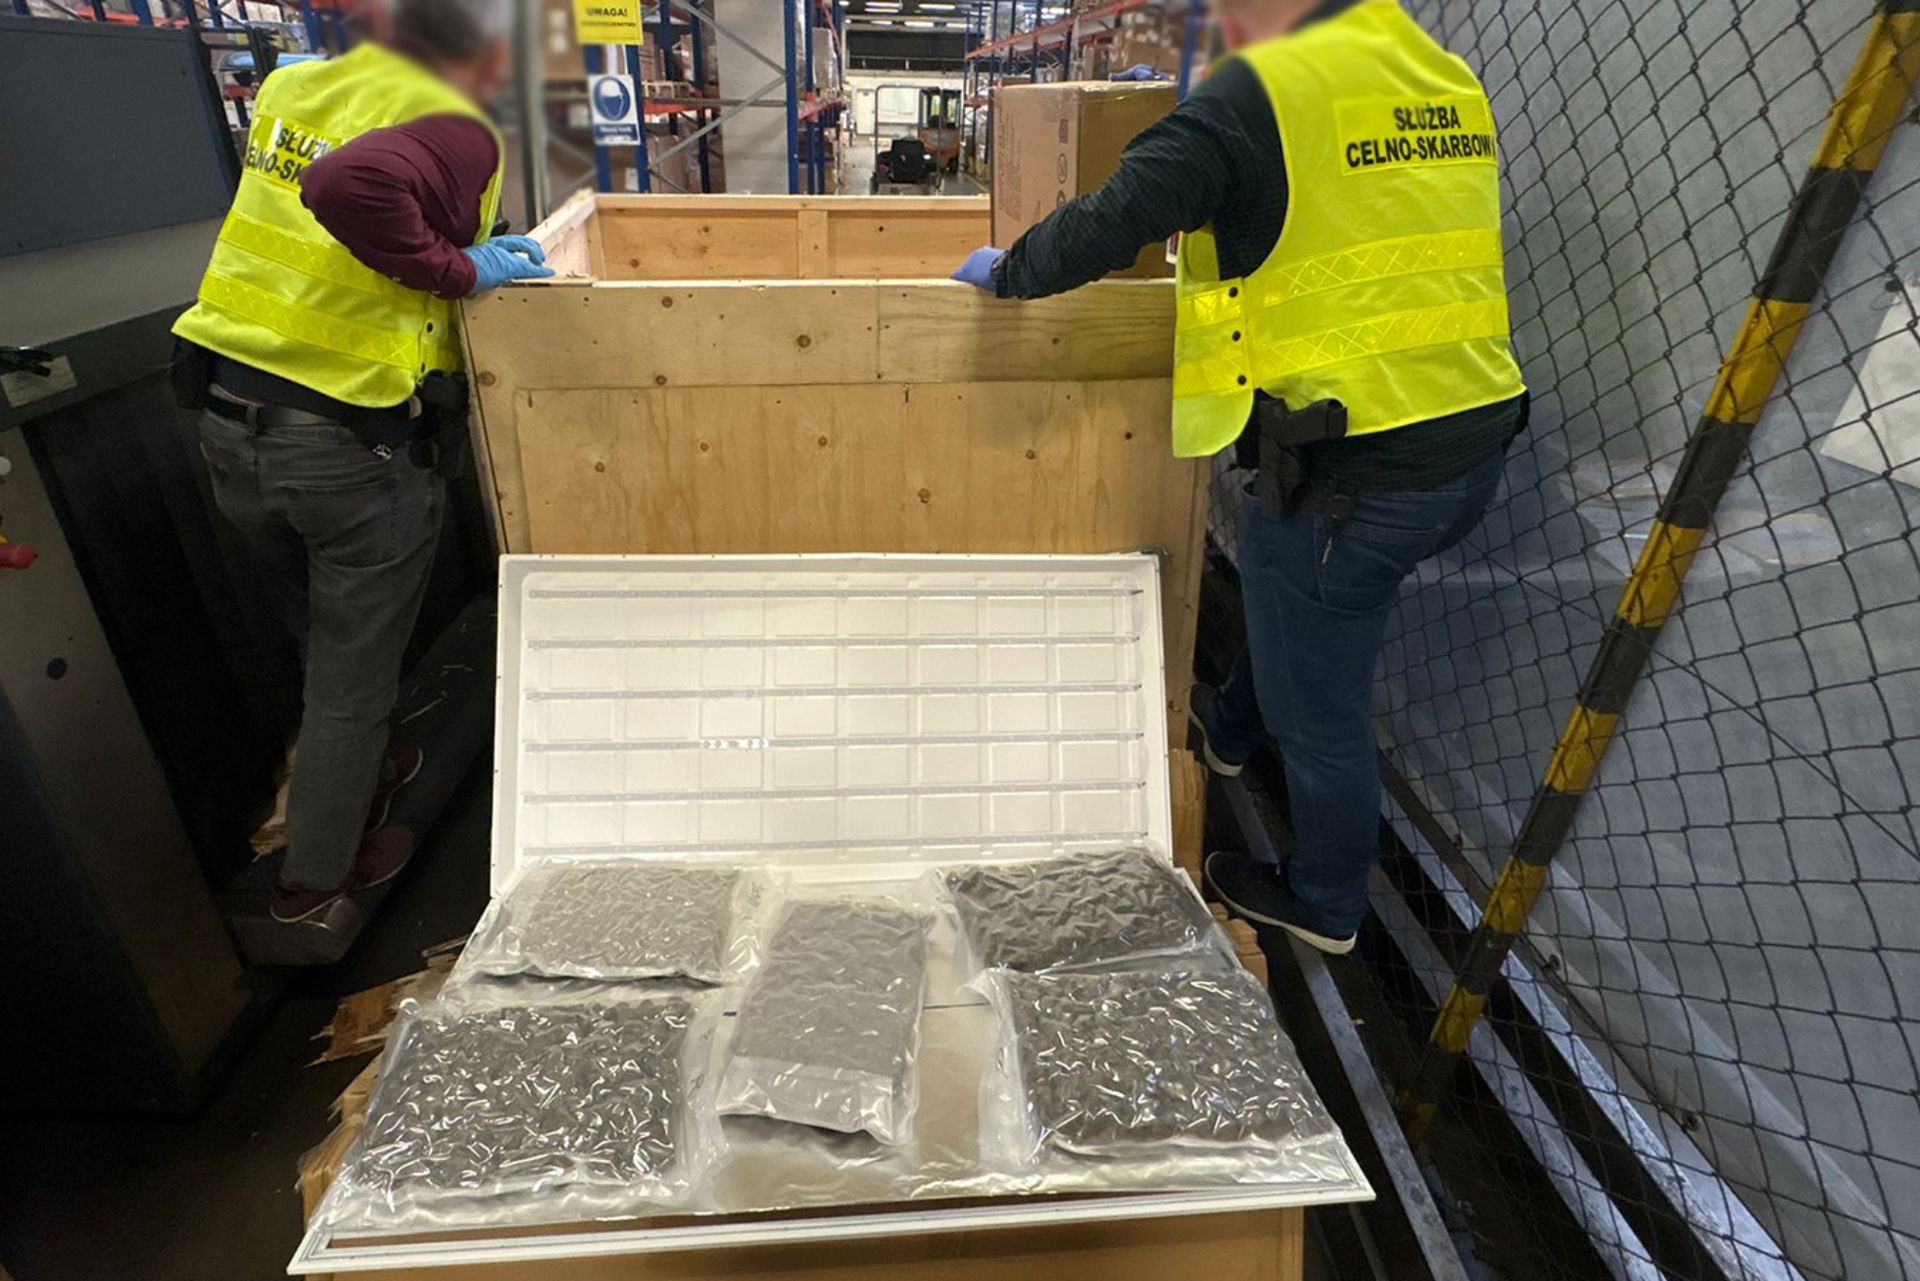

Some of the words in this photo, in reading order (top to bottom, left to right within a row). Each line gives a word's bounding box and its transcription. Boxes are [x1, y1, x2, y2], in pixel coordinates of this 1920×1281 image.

[586, 7, 628, 17] UWAGA!
[1394, 103, 1461, 131] SŁUŻBA
[1346, 134, 1497, 168] CELNO-SKARBOW
